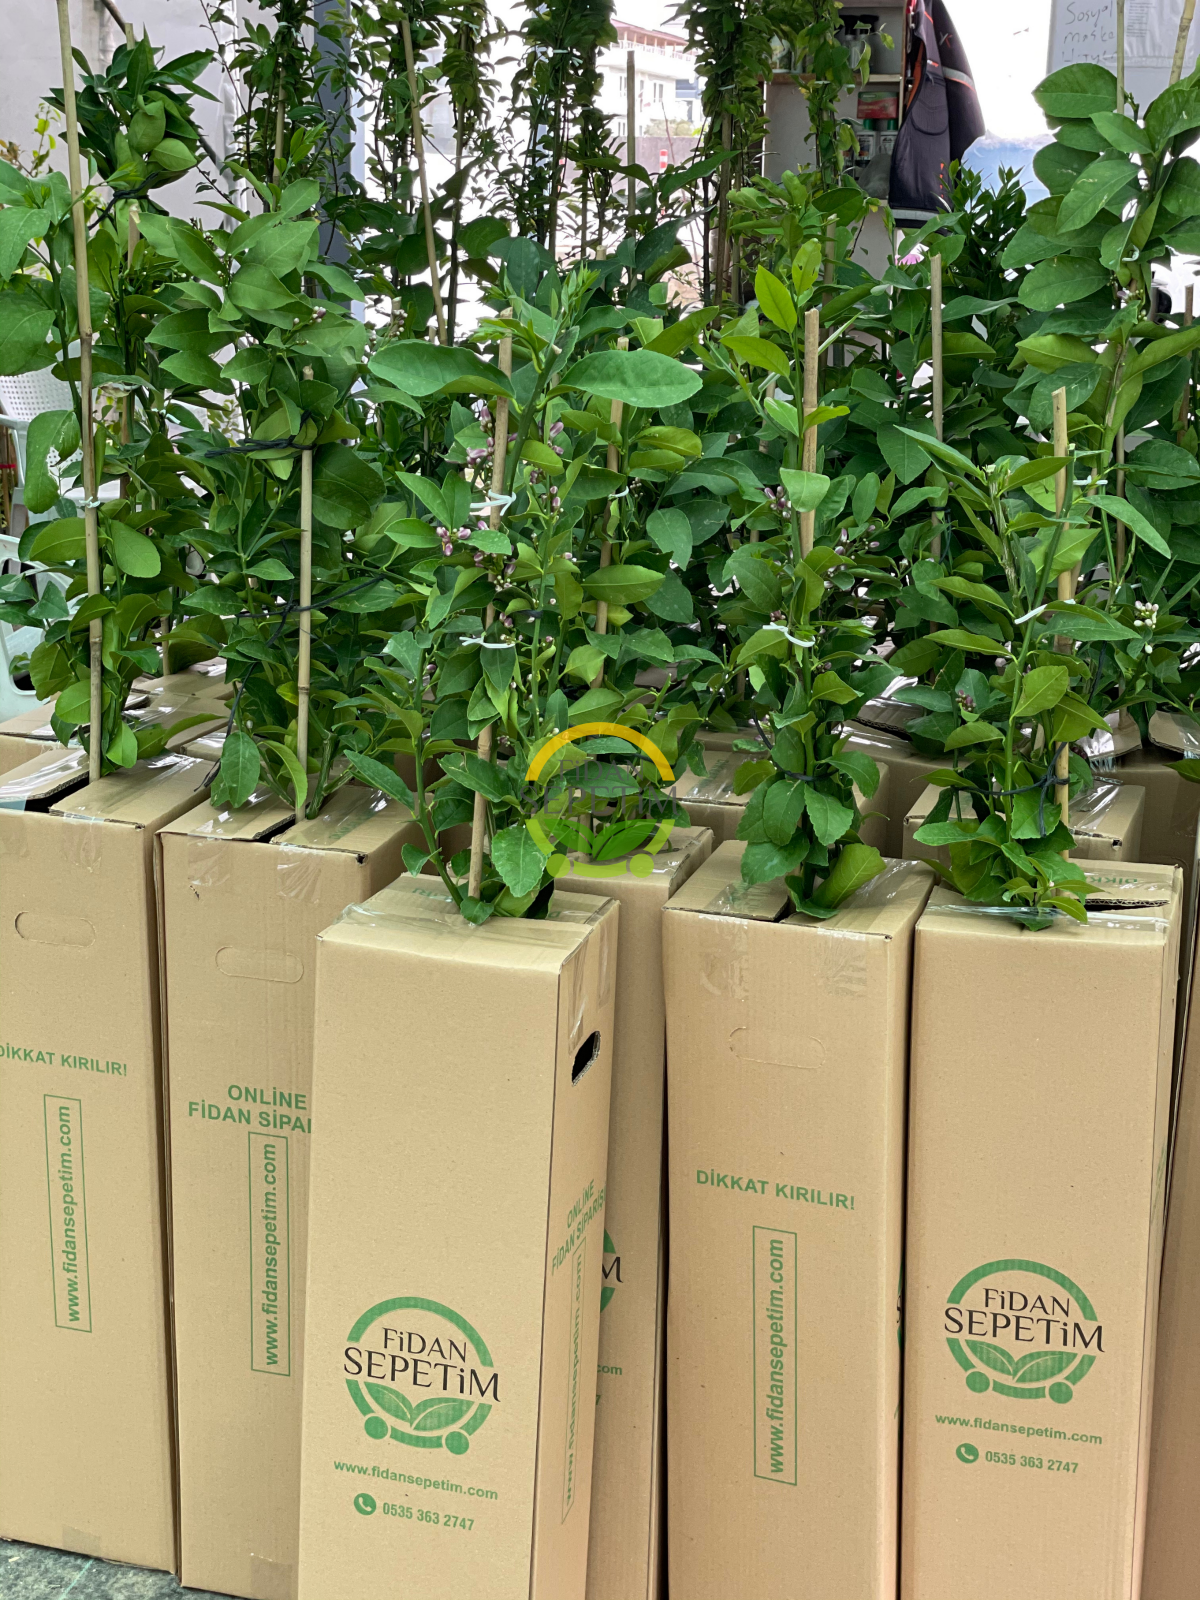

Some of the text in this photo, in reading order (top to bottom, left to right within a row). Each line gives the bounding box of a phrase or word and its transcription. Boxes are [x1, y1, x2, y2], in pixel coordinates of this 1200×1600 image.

[61, 1053, 127, 1077] KIRILIR!
[227, 1084, 307, 1111] ONLİNE
[188, 1099, 312, 1134] FİDAN SİPA
[696, 1169, 855, 1210] DİKKAT KIRILIR!
[57, 1105, 81, 1323] www.fidansepetim.com
[261, 1143, 281, 1366] www.fidansepetim.com
[551, 1229, 575, 1277] FİDAN
[766, 1239, 788, 1474] www.fidansepetim.com
[935, 1414, 1103, 1445] www.fidansepetim.com
[334, 1460, 498, 1500] www.fidansepetim.com
[985, 1451, 1079, 1473] 0535 363 2747
[383, 1502, 475, 1531] 0535 363 2747
